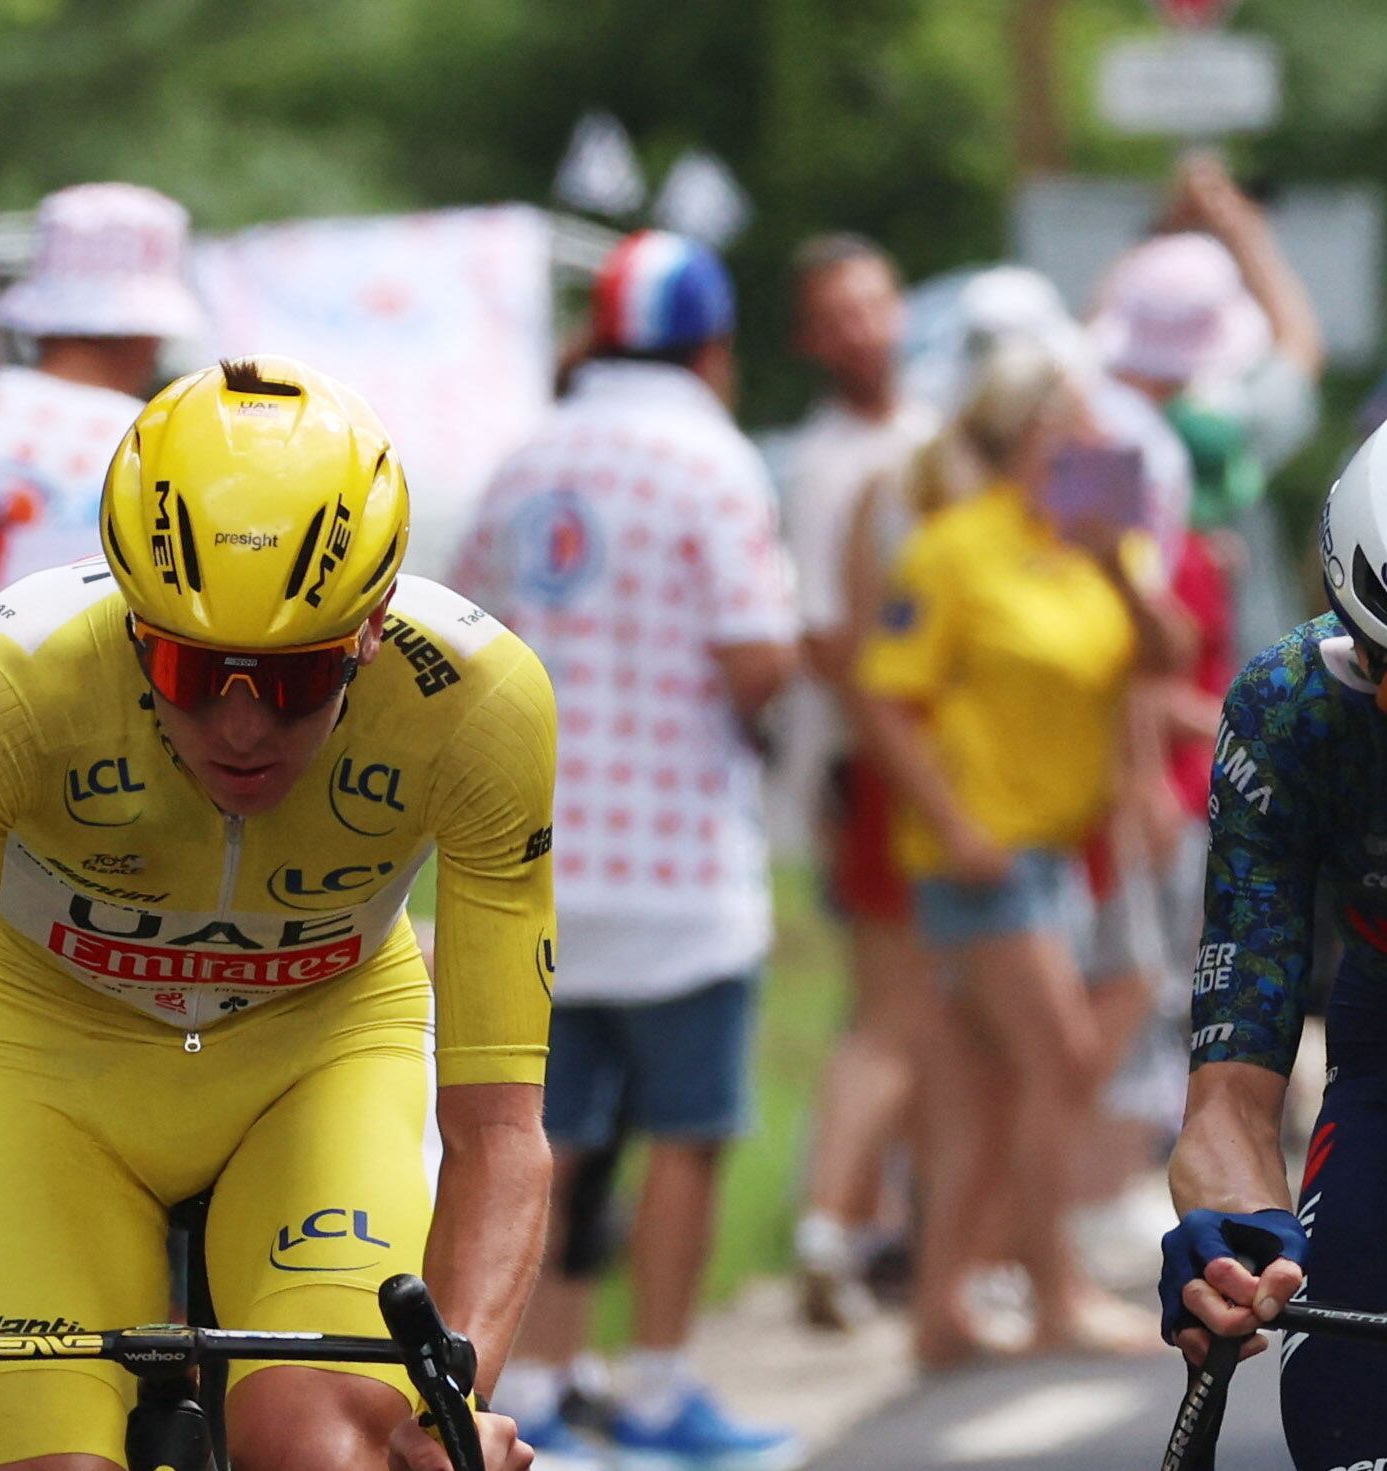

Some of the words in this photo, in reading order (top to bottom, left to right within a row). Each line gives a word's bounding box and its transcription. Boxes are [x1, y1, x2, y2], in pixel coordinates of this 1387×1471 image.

[152, 480, 183, 595] MET
[214, 530, 279, 551] presight
[305, 493, 351, 608] MET
[68, 757, 146, 802] LCL
[339, 758, 405, 812] LCL
[285, 861, 395, 896] LC
[68, 893, 355, 950] UAE
[61, 928, 352, 983] Emirates
[279, 1208, 391, 1251] LCL
[125, 1350, 186, 1362] wahoo
